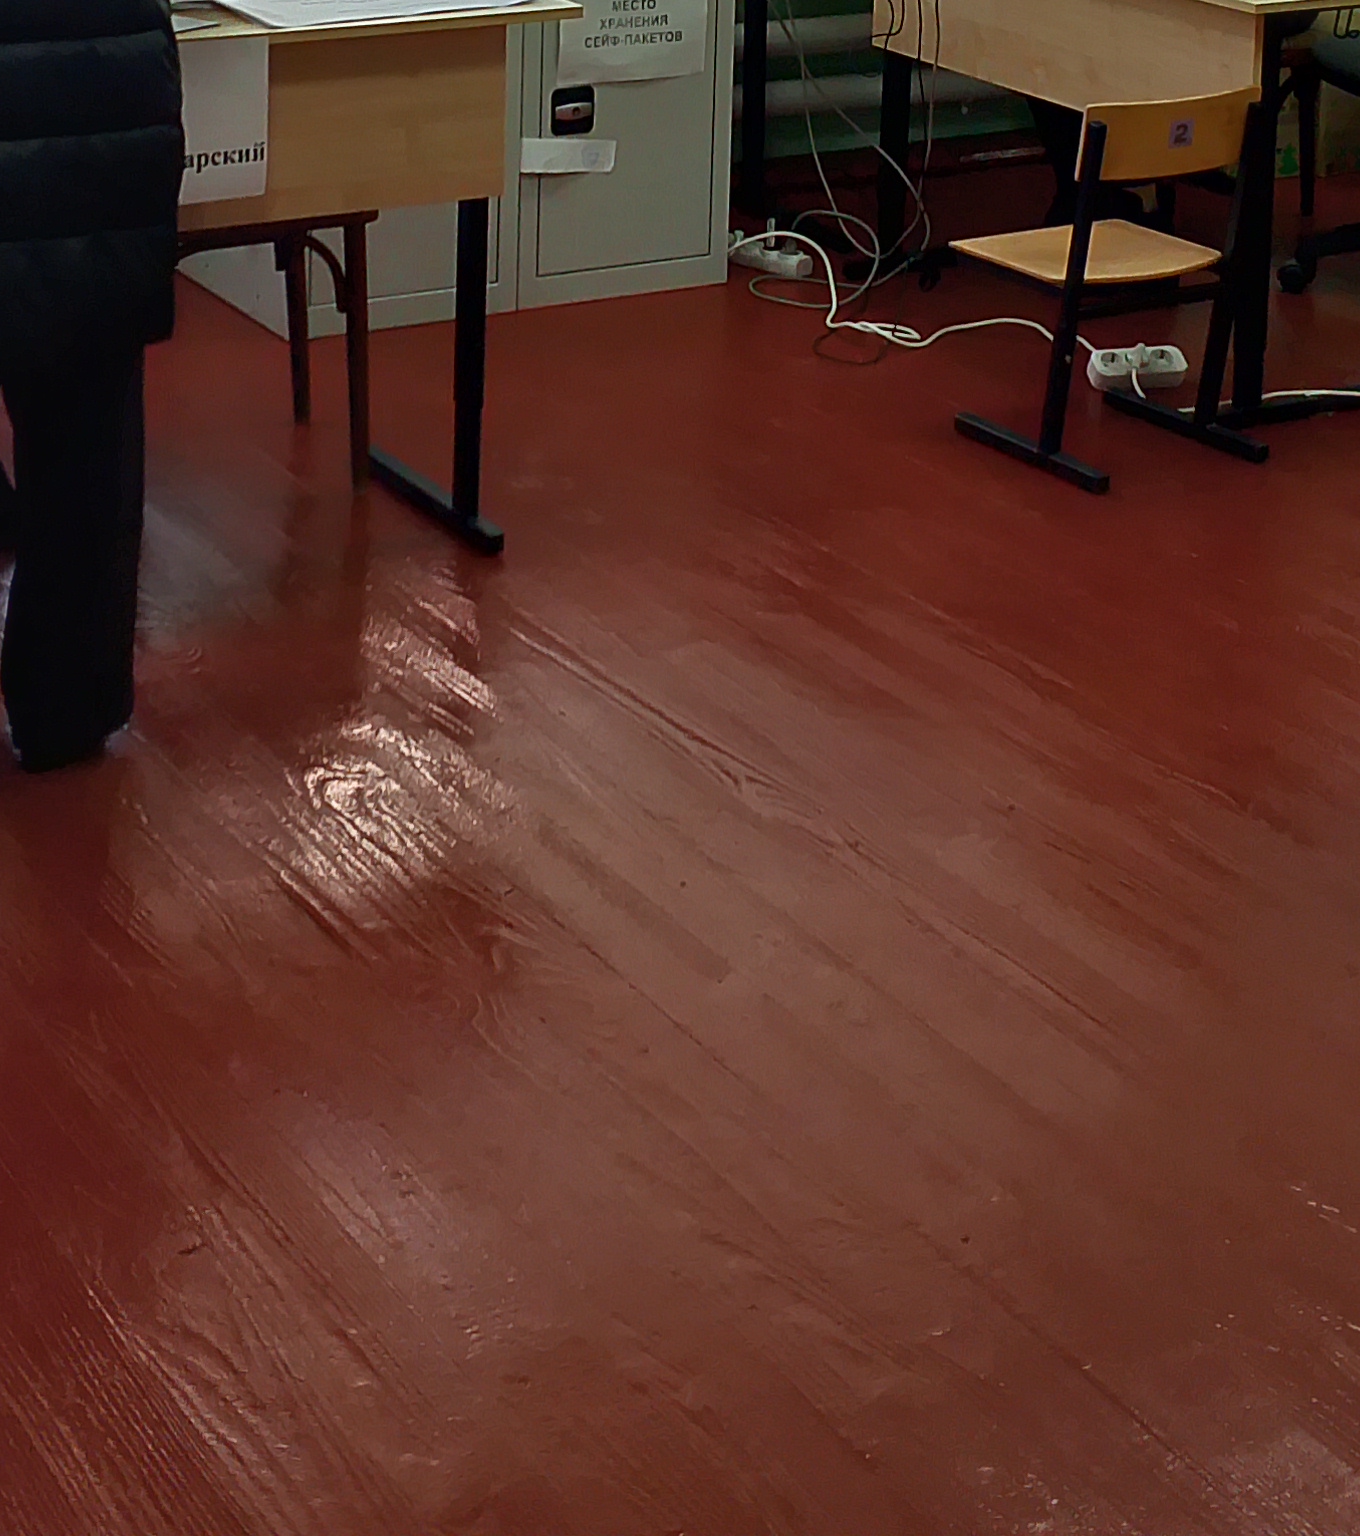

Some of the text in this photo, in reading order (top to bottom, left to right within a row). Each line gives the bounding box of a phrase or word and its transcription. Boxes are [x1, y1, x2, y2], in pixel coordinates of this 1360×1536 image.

[599, 14, 669, 31] ХРАНЕНИЯ
[584, 30, 683, 49] СЕЙФ-ПАКЕТОВ
[1173, 123, 1189, 145] 2
